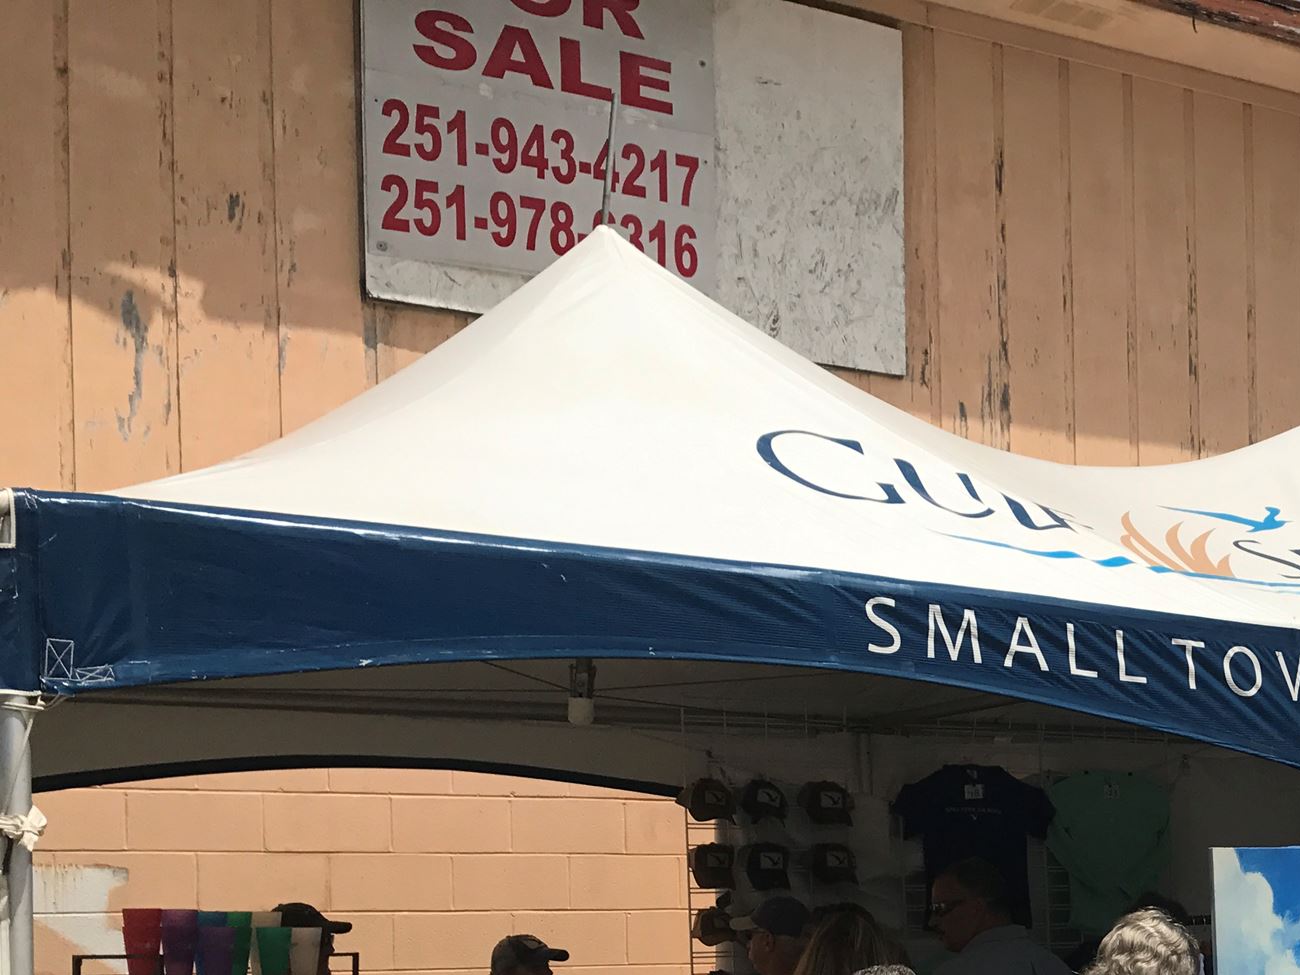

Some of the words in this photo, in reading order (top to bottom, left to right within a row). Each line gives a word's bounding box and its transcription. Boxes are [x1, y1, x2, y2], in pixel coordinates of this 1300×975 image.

[412, 9, 674, 115] SALE
[381, 98, 700, 207] 251-943-4217
[864, 596, 1148, 685] SMALL
